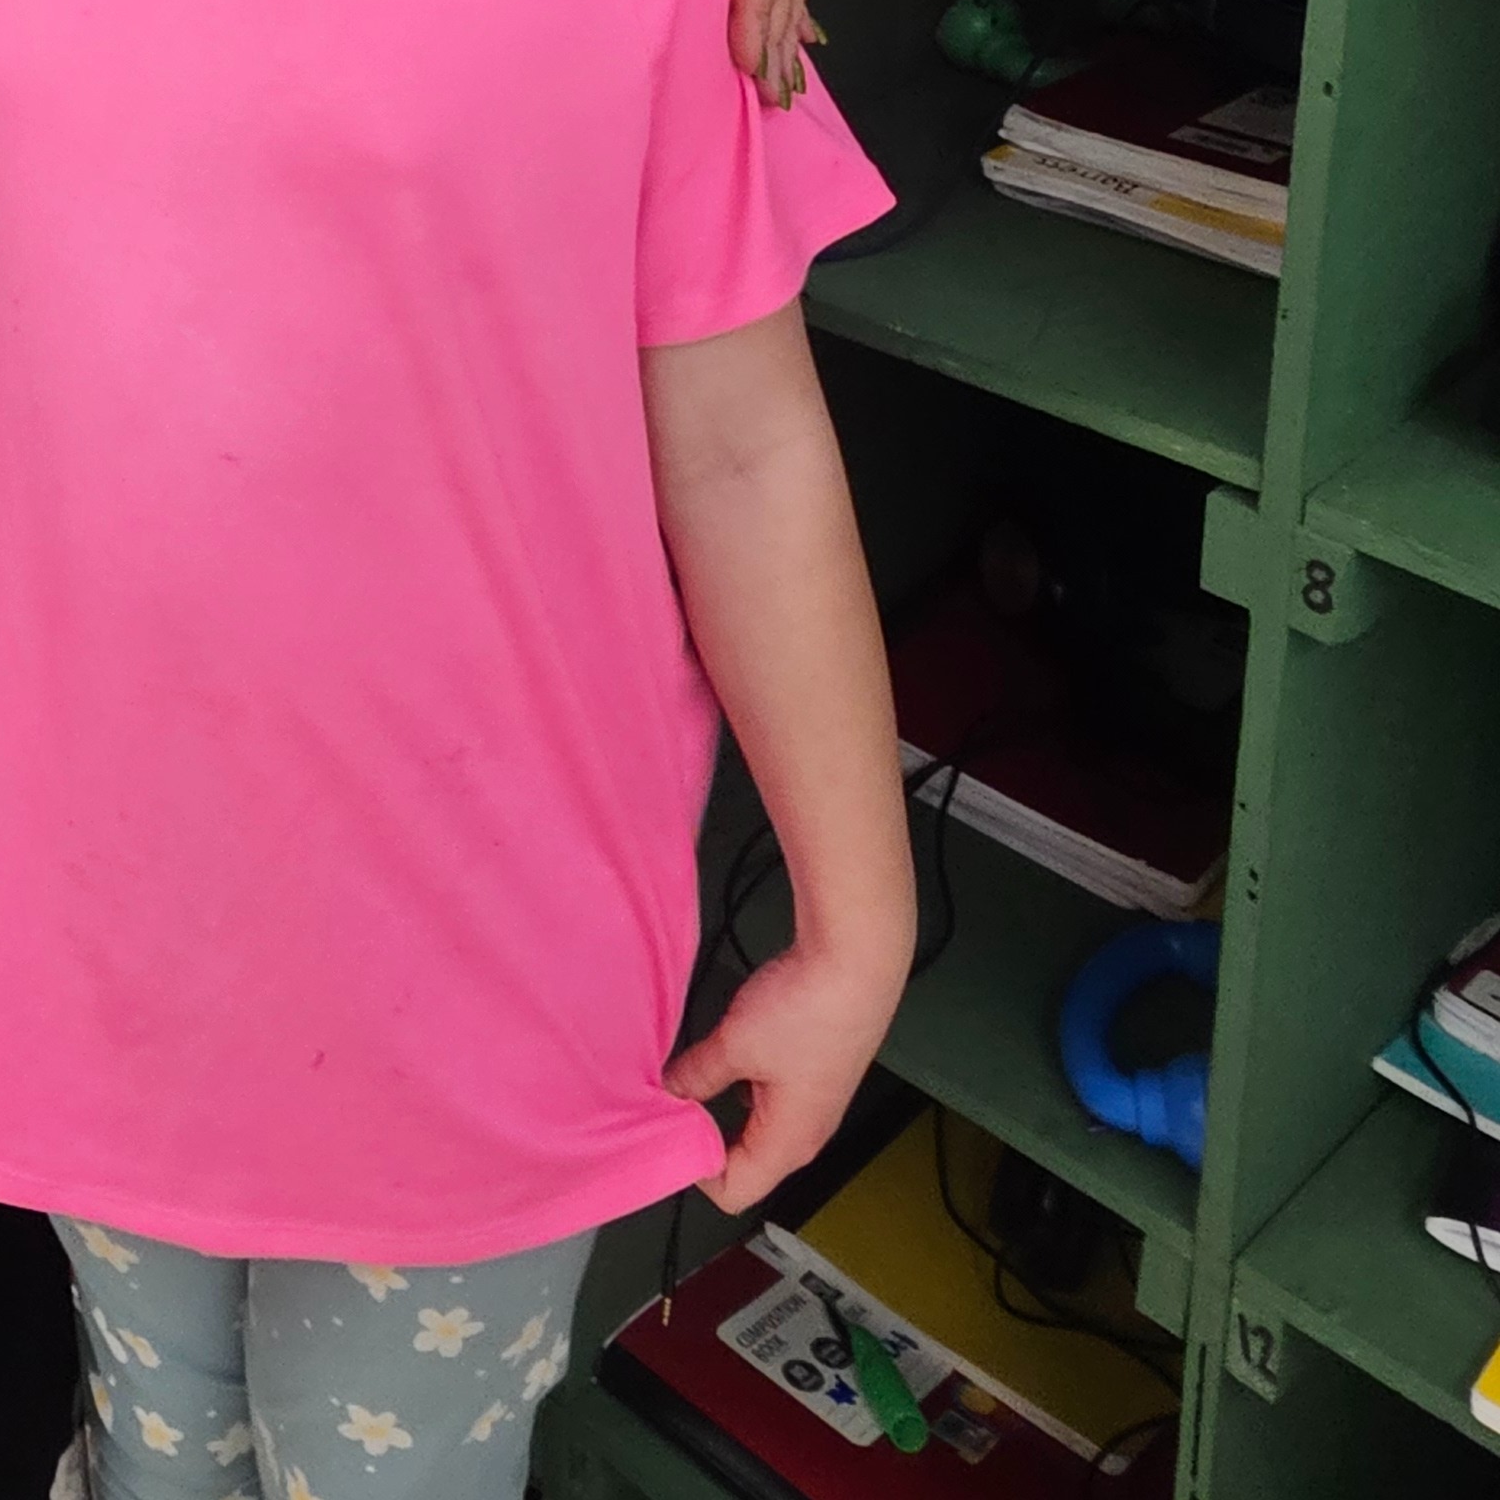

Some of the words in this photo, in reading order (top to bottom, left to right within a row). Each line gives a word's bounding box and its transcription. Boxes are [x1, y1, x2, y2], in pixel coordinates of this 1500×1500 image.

[1301, 558, 1336, 616] 8
[735, 1293, 808, 1349] COMPOSITION
[750, 1334, 790, 1364] BOOK
